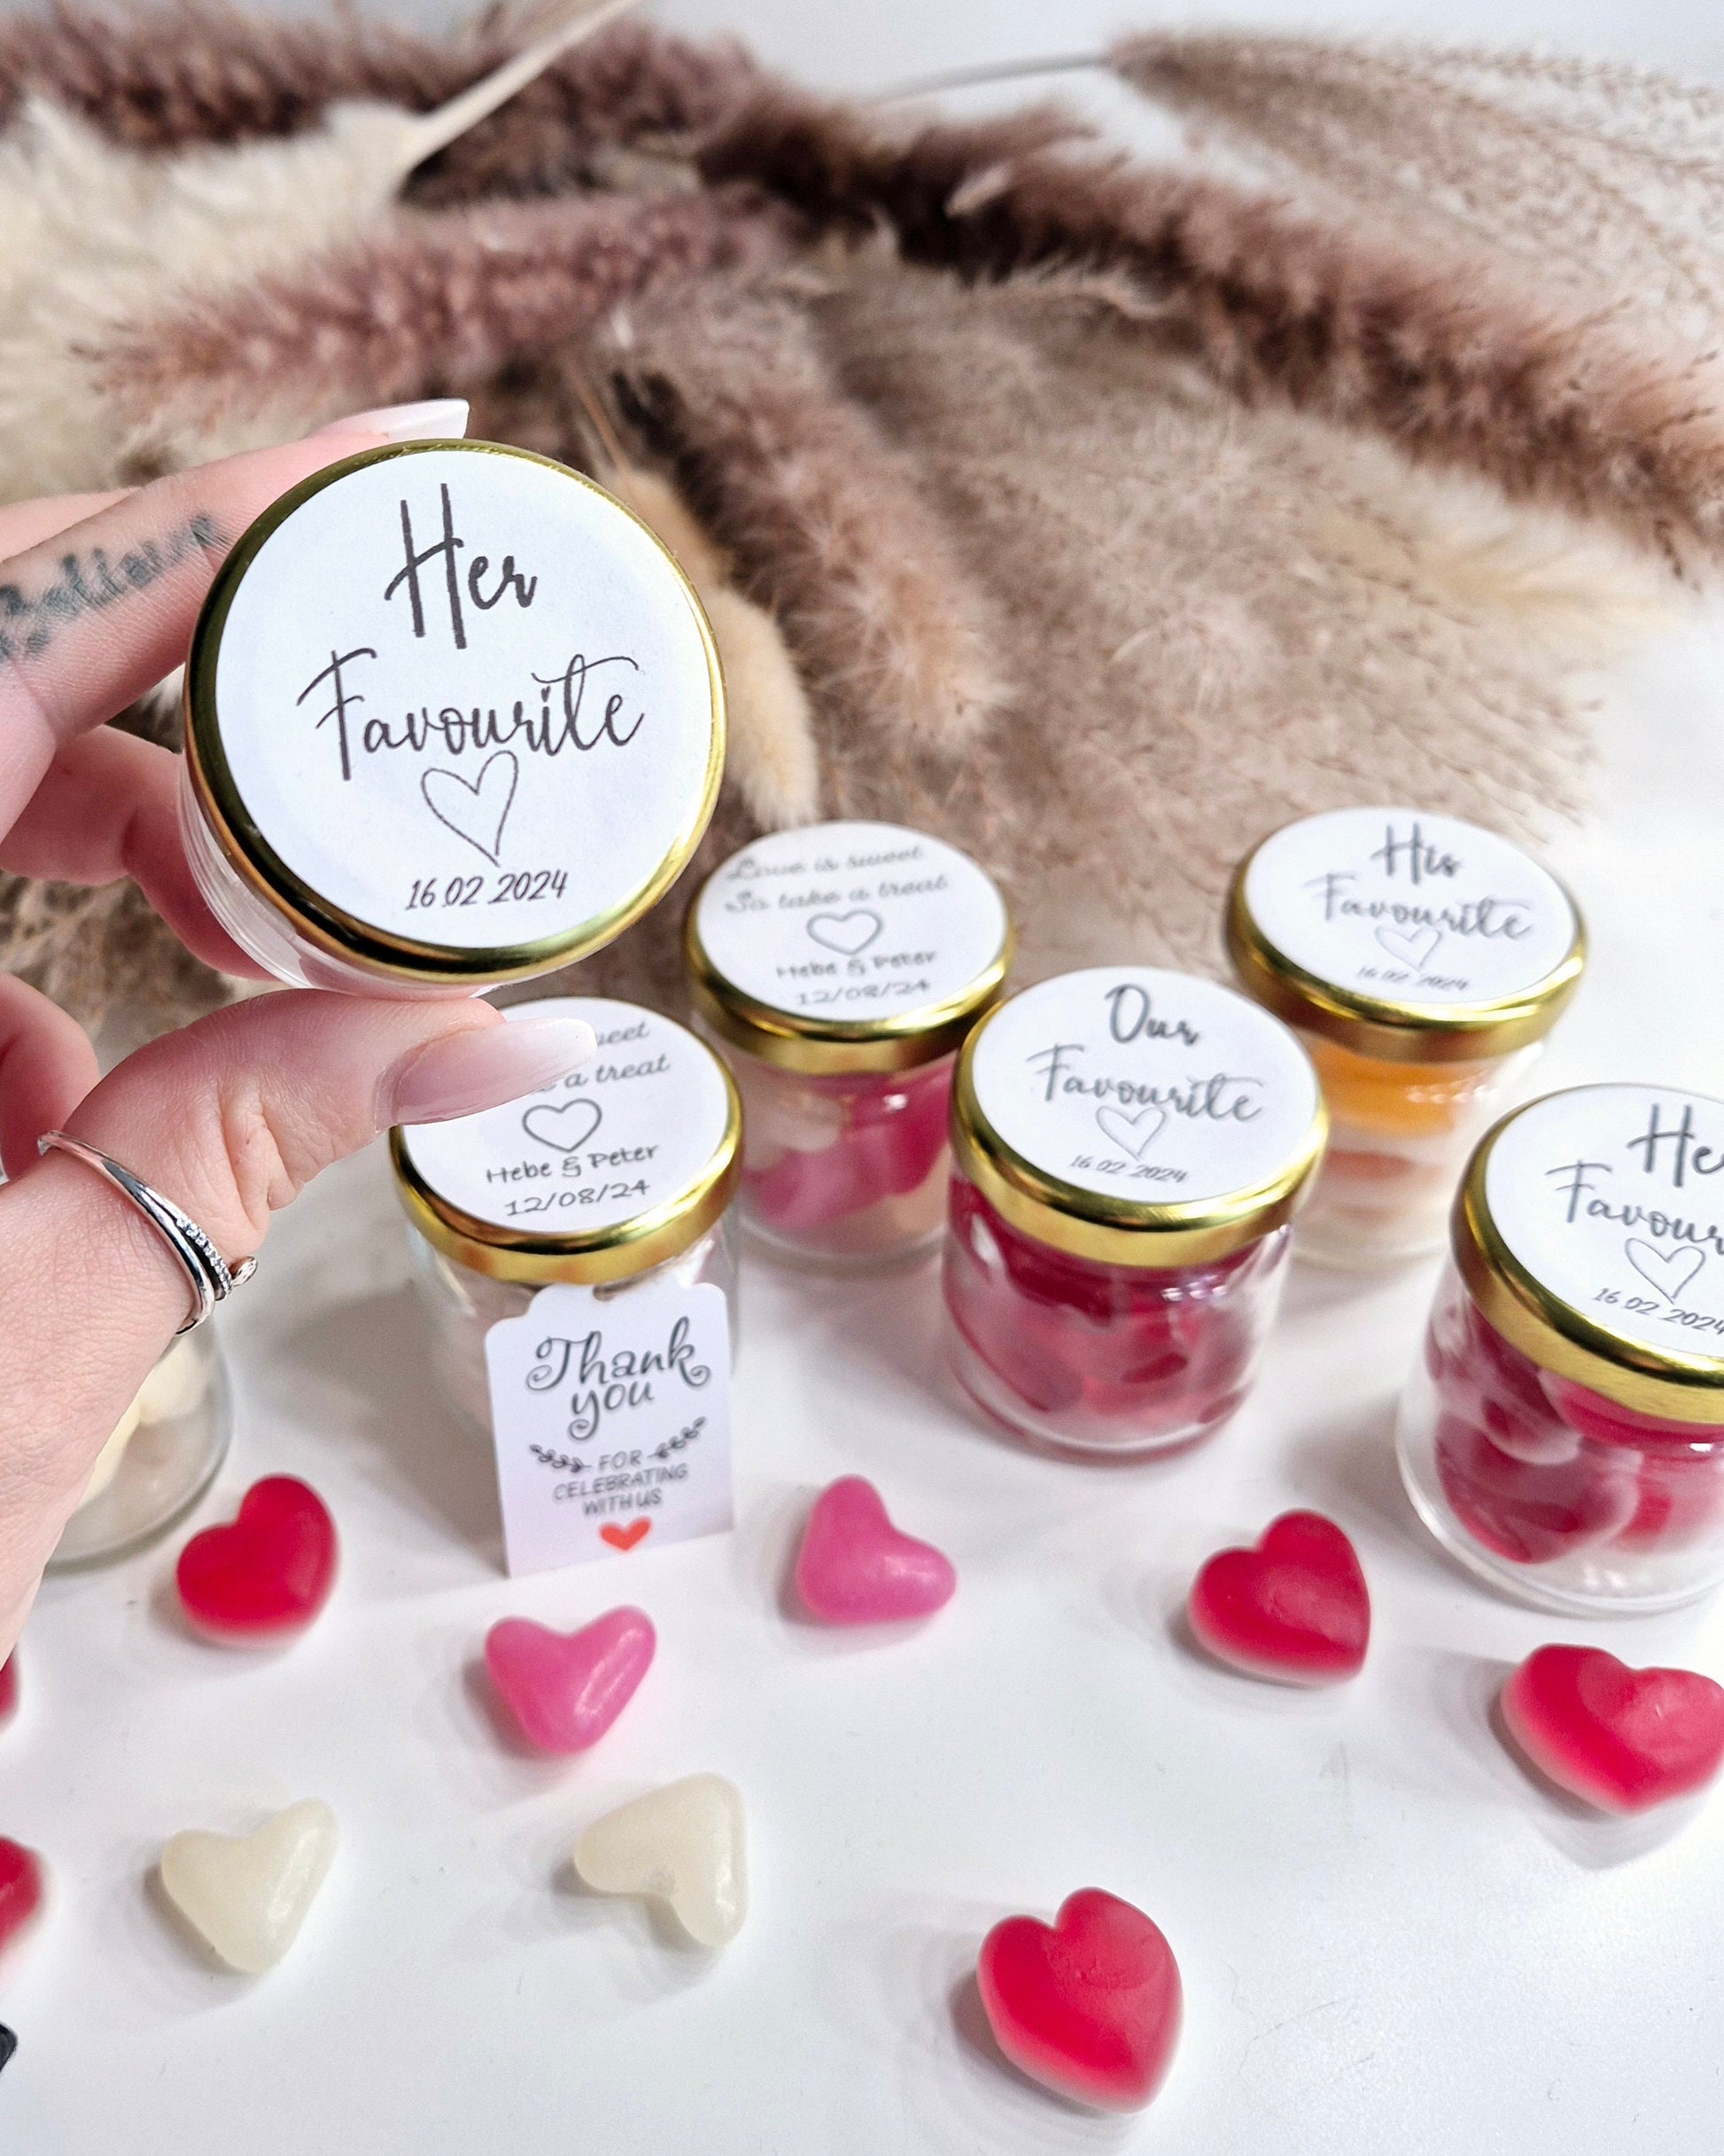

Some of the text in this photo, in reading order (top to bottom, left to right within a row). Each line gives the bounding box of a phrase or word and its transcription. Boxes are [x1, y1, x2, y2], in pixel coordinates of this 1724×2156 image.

[384, 483, 538, 650] Her
[297, 648, 645, 782] Favourite
[1370, 821, 1462, 885] His
[1303, 871, 1533, 940] Favourite
[596, 1021, 651, 1047] eet
[1105, 983, 1199, 1046] Our
[595, 1053, 671, 1083] treat
[1025, 1043, 1264, 1122] Favourite
[485, 1160, 552, 1184] Hebe
[586, 1145, 659, 1170] Peter
[1626, 1102, 1724, 1188] He
[504, 1179, 650, 1217] 12/08/24
[1544, 1158, 1724, 1255] Favour
[526, 1316, 711, 1391] Thank
[568, 1381, 654, 1441] you
[553, 1463, 689, 1501] CELEBRATING
[598, 1449, 643, 1472] FOR
[582, 1488, 663, 1516] WITH US
